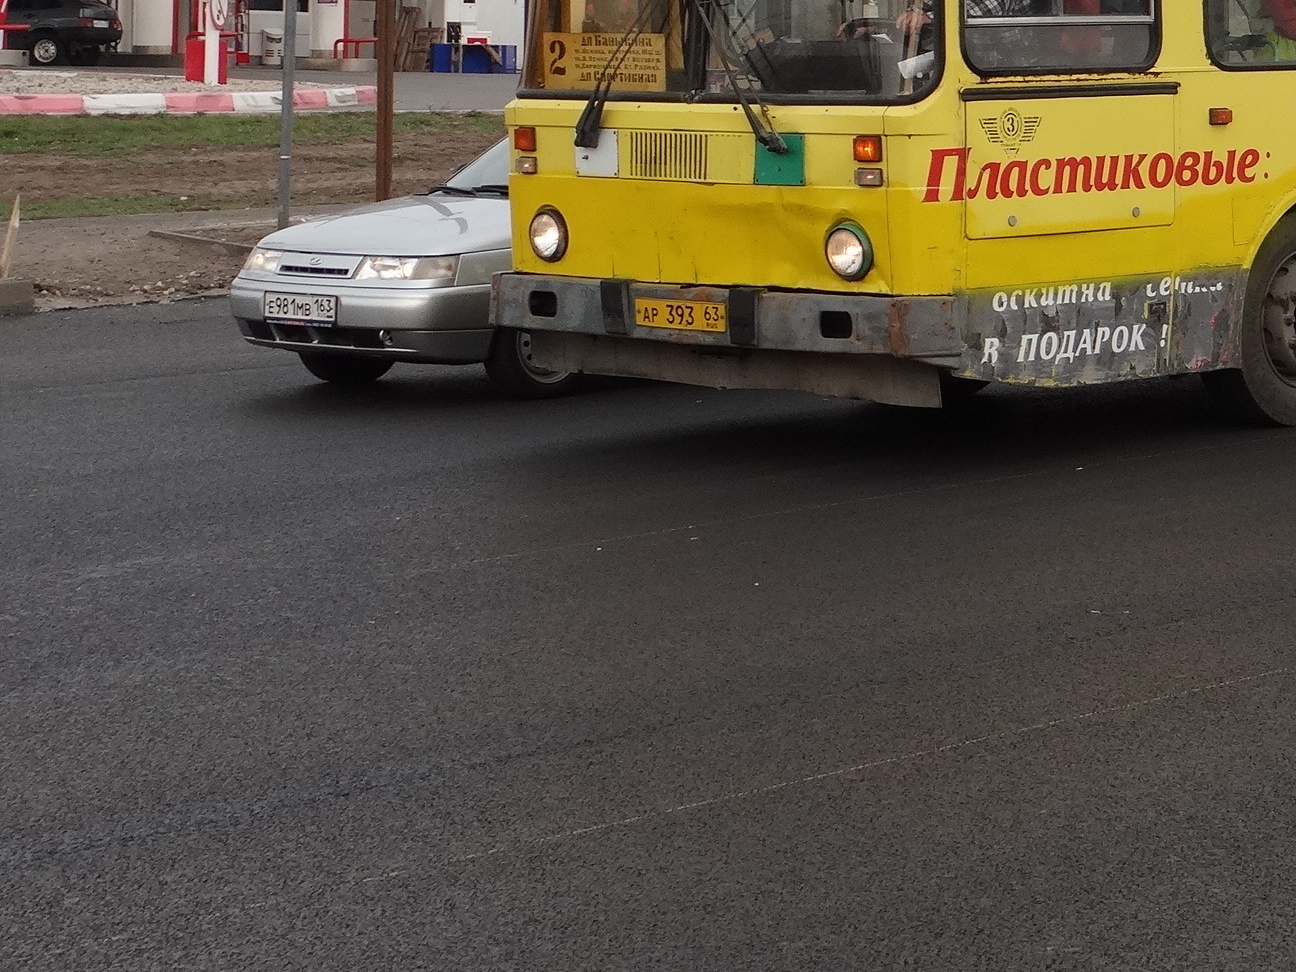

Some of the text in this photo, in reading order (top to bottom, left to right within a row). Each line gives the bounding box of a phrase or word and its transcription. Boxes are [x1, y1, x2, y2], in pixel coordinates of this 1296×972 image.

[549, 39, 567, 76] 2
[1007, 117, 1014, 132] 3
[921, 147, 1272, 203] Пластиковые:
[268, 297, 333, 316] Е981МВ 163
[643, 305, 719, 325] АР 393 63
